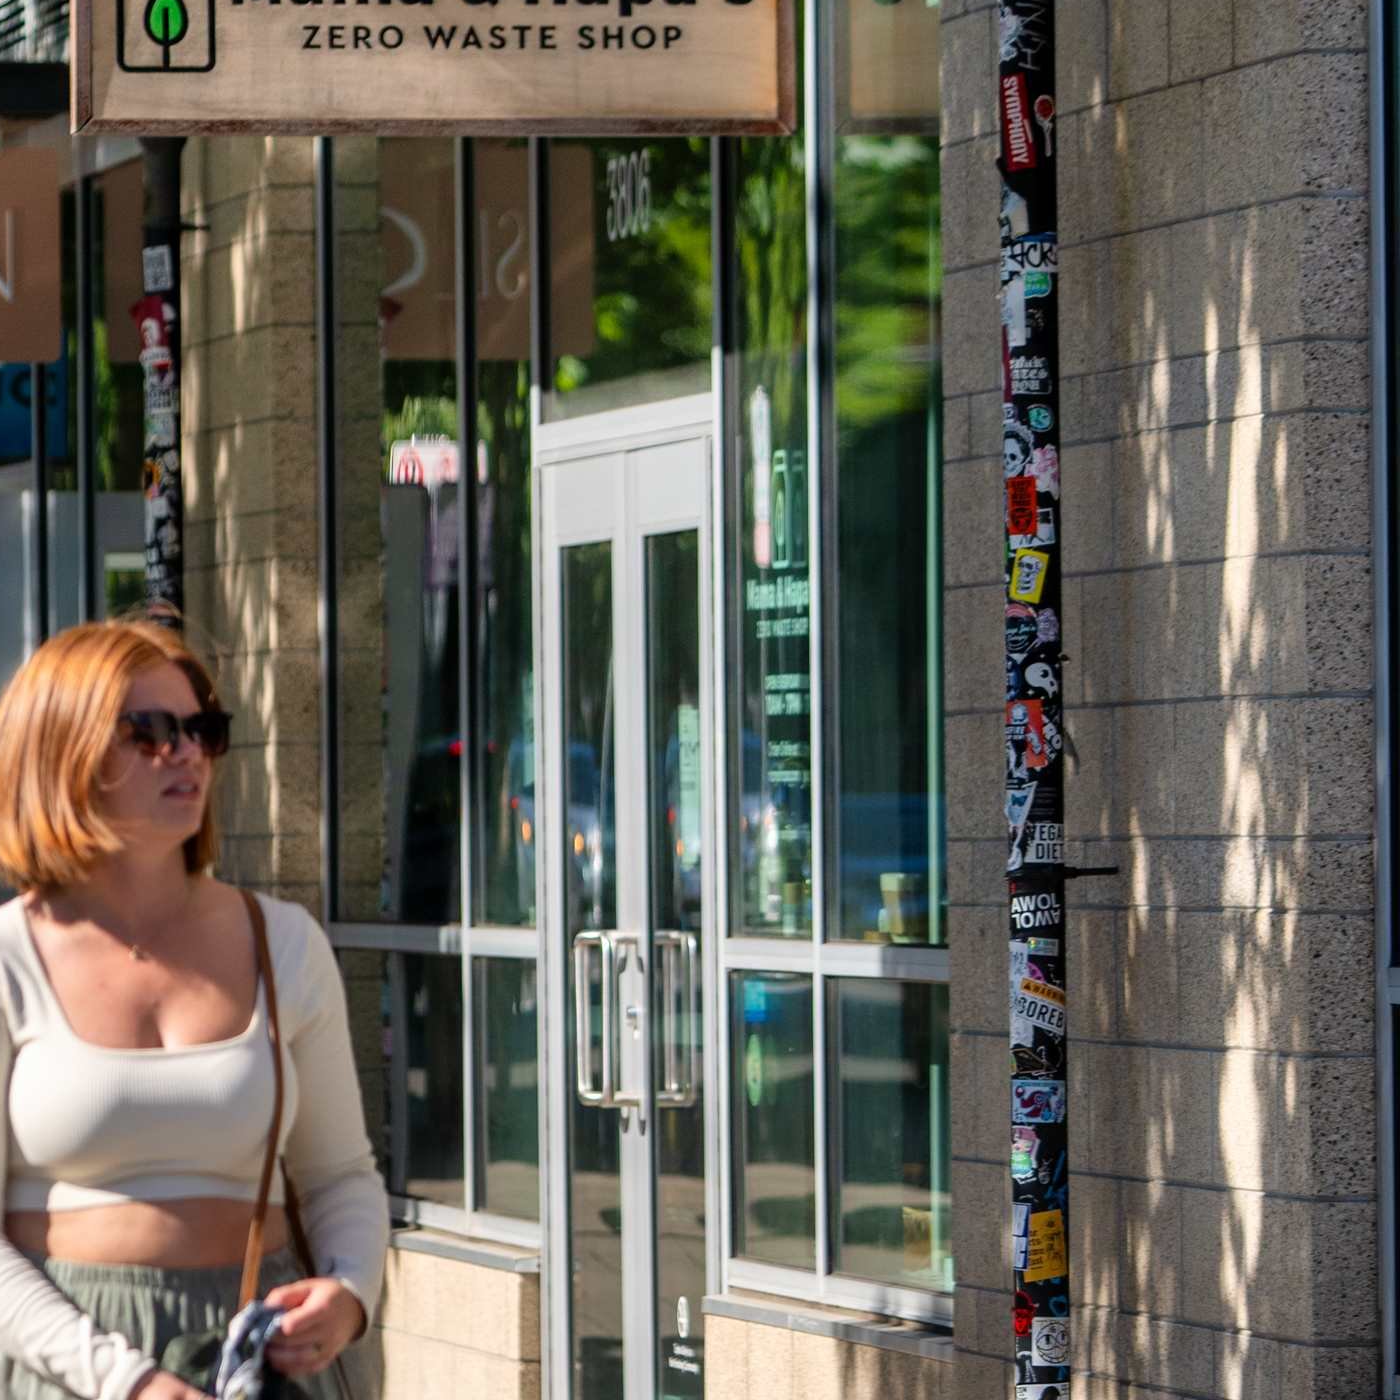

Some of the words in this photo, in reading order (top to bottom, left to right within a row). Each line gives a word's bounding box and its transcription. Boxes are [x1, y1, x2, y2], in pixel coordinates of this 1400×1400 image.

[302, 25, 403, 50] ZERO
[425, 25, 557, 50] WASTE
[578, 25, 683, 50] SHOP
[606, 149, 650, 241] 3806
[1011, 892, 1060, 914] AWOL
